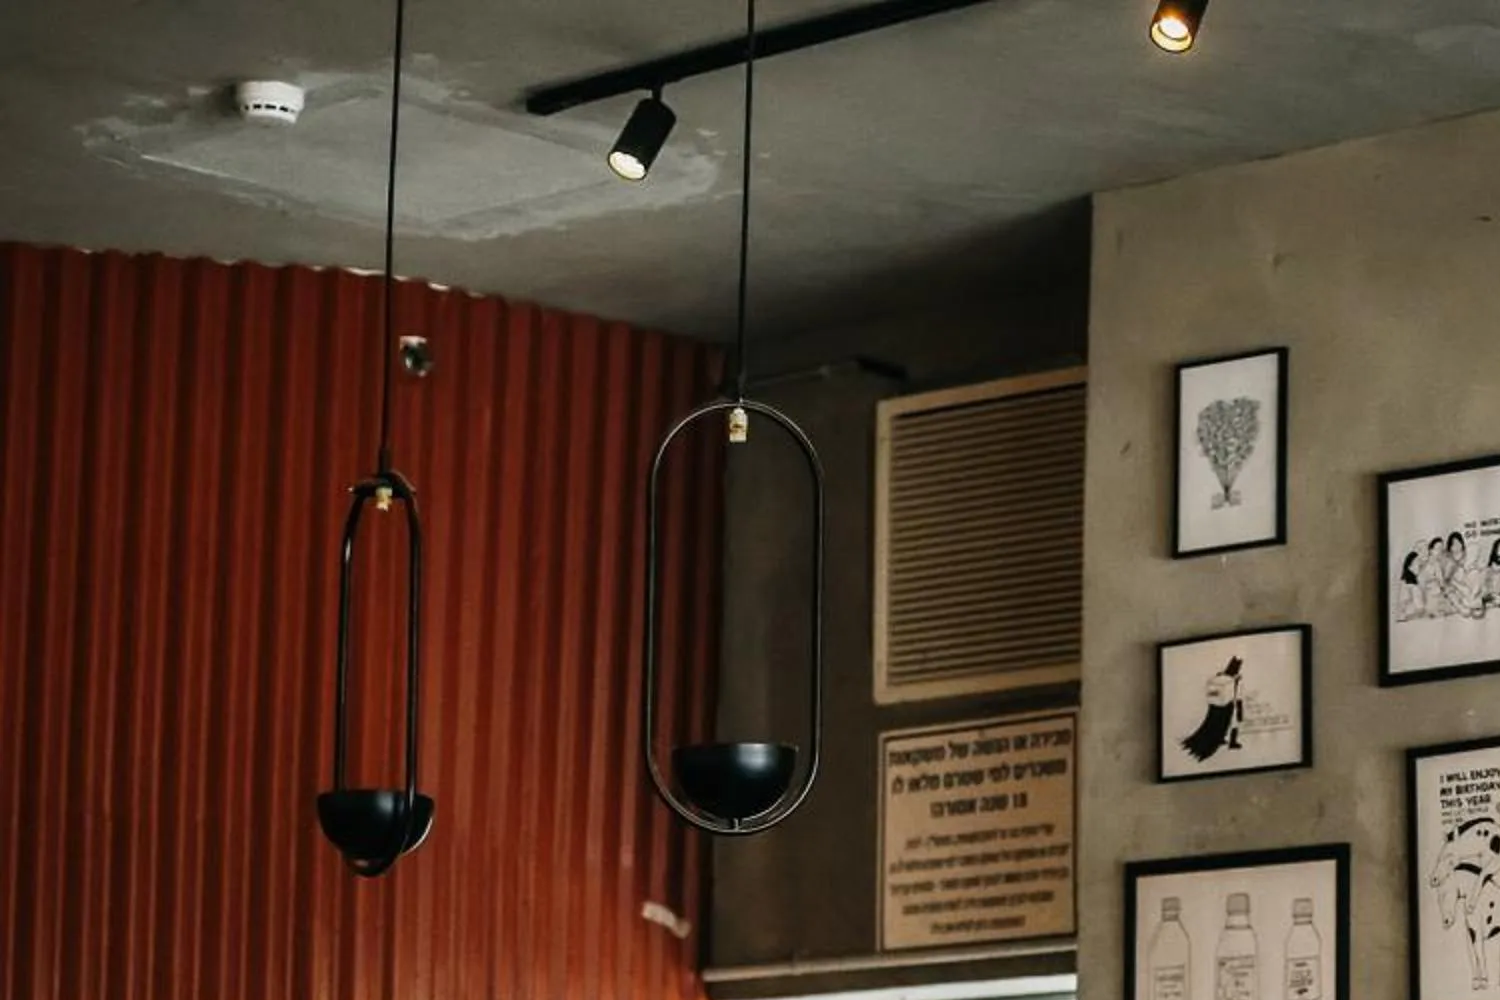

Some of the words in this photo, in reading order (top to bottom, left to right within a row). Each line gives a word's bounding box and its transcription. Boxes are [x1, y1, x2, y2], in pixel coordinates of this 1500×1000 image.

[1446, 771, 1468, 782] WILL
[1440, 797, 1463, 809] THIS
[1466, 794, 1491, 806] YEAR
